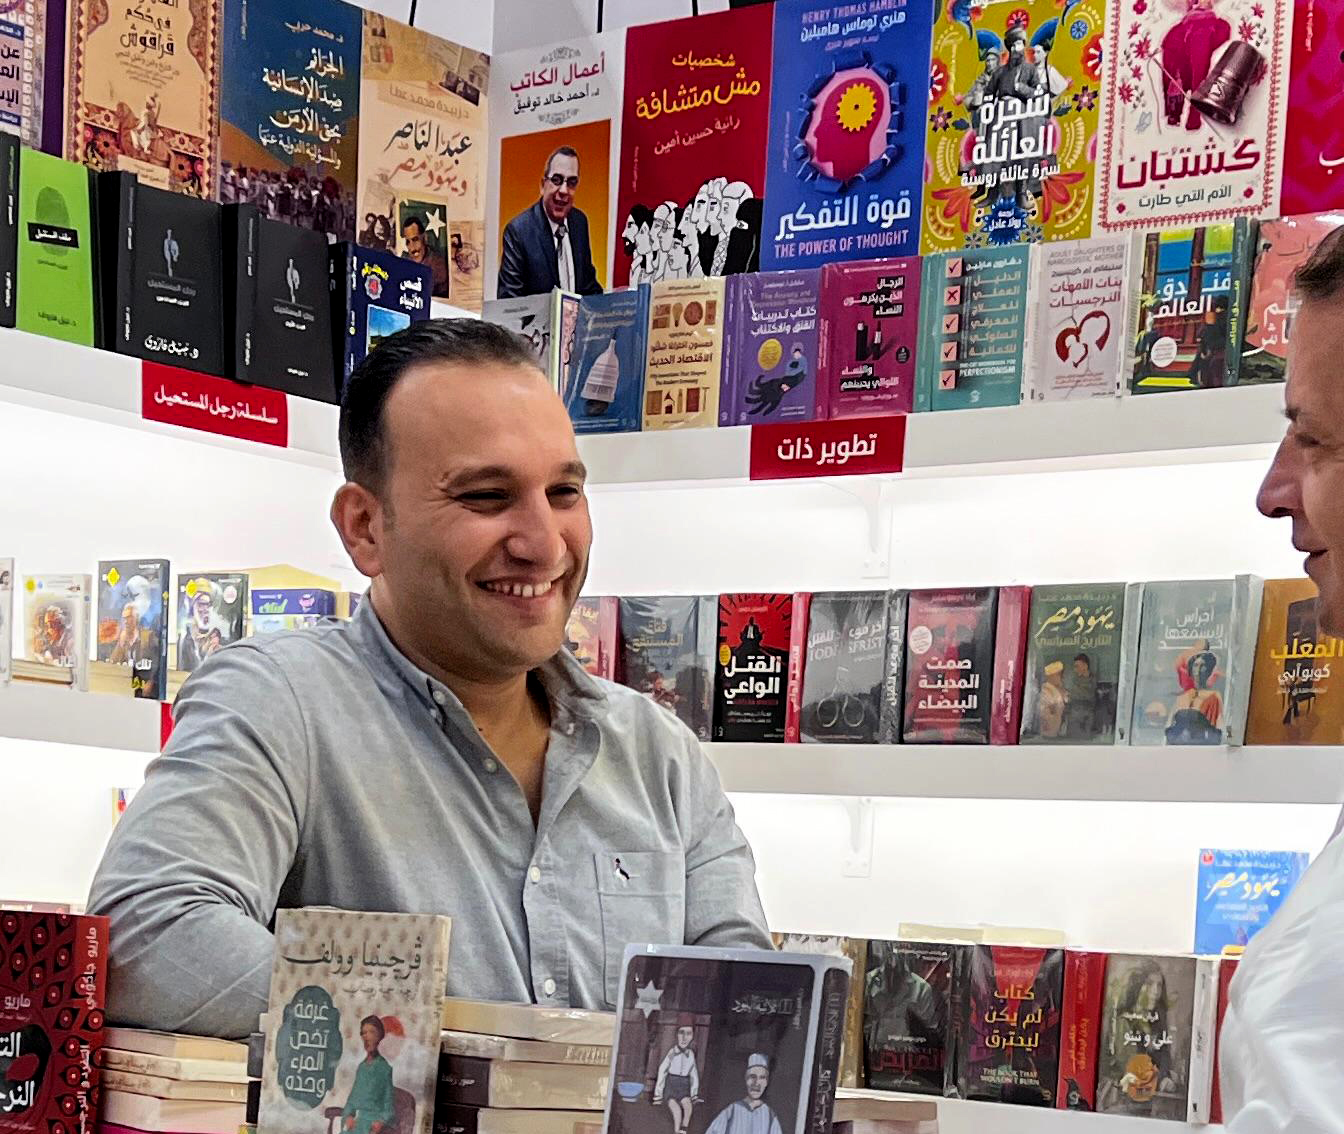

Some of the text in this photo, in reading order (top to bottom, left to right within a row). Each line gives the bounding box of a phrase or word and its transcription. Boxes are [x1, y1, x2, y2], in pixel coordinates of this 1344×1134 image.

[2, 38, 21, 59] عن
[671, 50, 736, 70] شخصيات
[510, 52, 605, 94] أعمال الكاتب
[636, 67, 761, 120] مش متشافة
[978, 86, 1051, 127] شجرة
[971, 123, 1055, 166] العائلة
[1173, 186, 1203, 206] التي
[774, 191, 911, 241] قوة التفكير
[774, 230, 909, 258] THE POWER OF THOUGHT
[1152, 296, 1212, 318] العالم
[154, 384, 278, 424] سلسلة رجل المستحيل
[778, 432, 878, 465] تطوير ذات
[724, 655, 781, 677] القتل
[925, 655, 972, 671] صمت
[724, 677, 780, 699] الواعي
[917, 669, 980, 694] المدينة
[916, 691, 979, 713] البيضاء
[4, 995, 31, 1010] ماريو
[994, 986, 1035, 1002] كتاب
[294, 999, 329, 1020] غرفة
[985, 1007, 1042, 1027] لم يكن
[290, 1028, 329, 1049] تخص
[985, 1030, 1039, 1049] ليحترق
[290, 1052, 323, 1072] المرء
[286, 1073, 326, 1097] وحده
